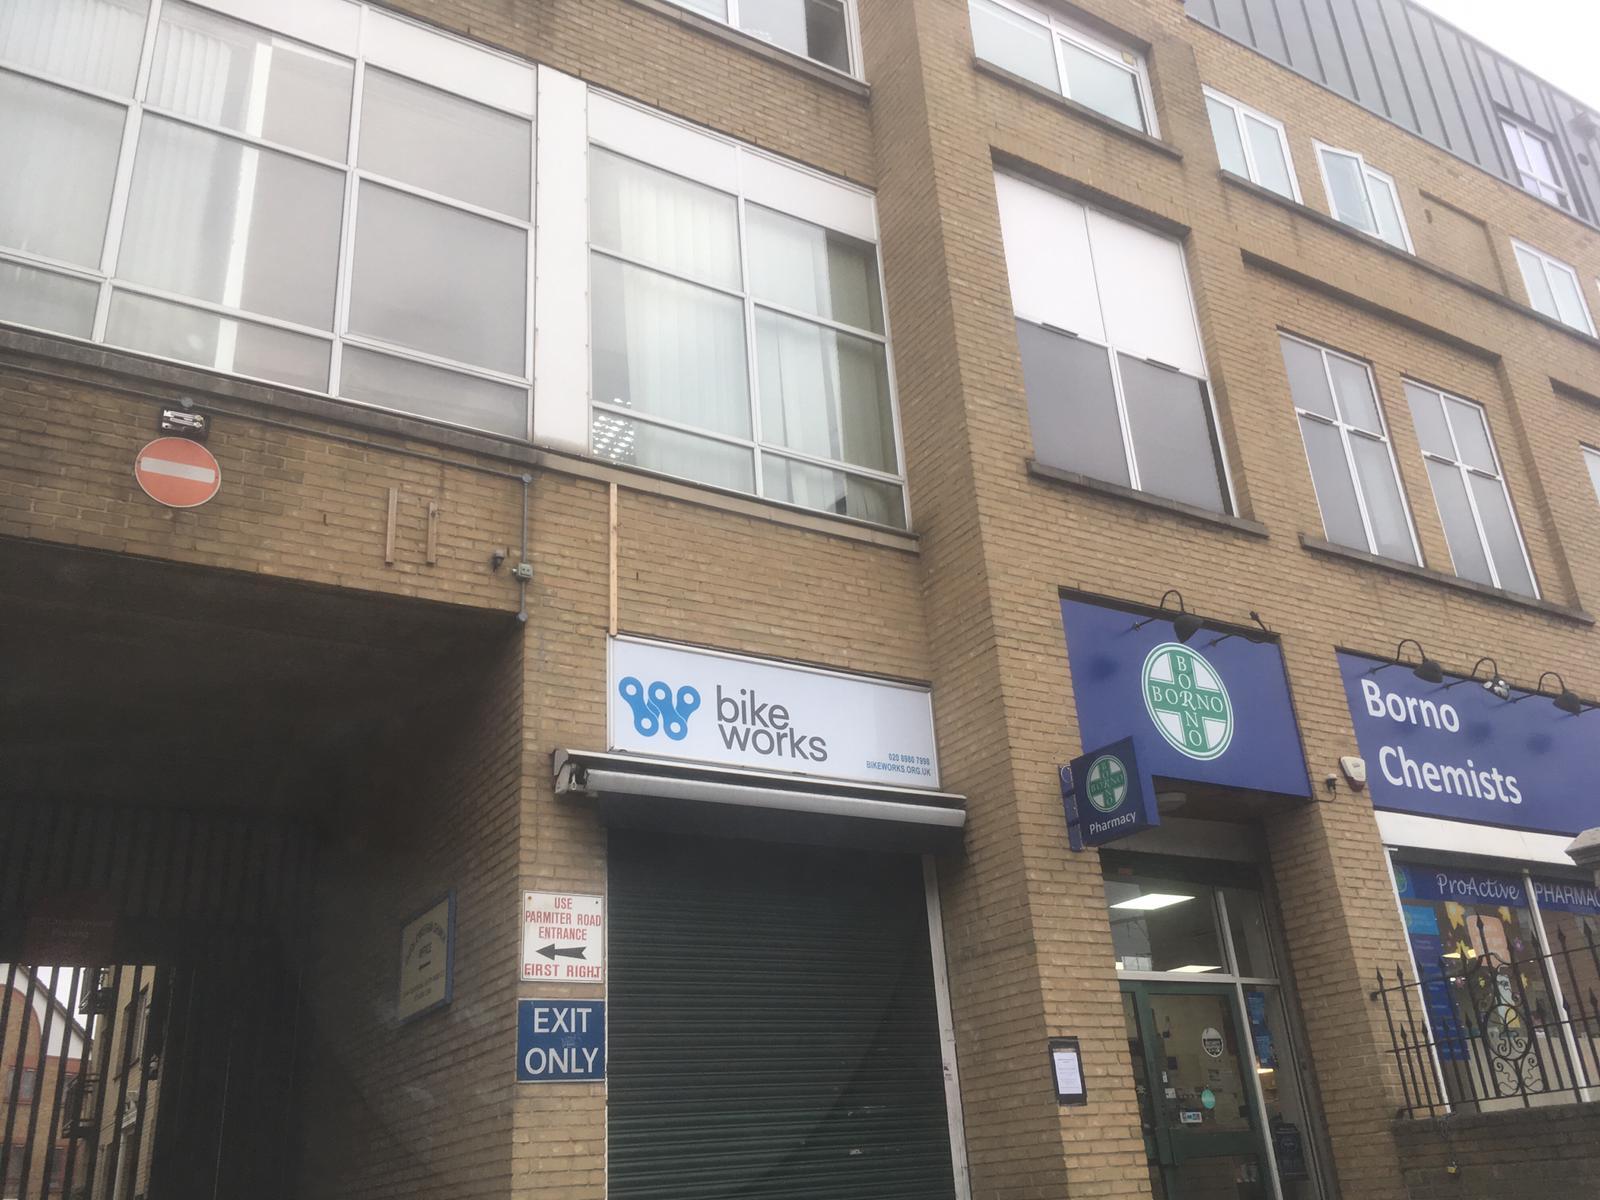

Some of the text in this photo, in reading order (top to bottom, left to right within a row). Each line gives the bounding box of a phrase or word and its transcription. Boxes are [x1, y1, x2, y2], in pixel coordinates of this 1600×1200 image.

[716, 684, 790, 730] bike
[1152, 685, 1223, 713] BORNO
[1176, 655, 1202, 746] BORNO
[1361, 678, 1460, 733] Borno
[717, 723, 828, 762] works
[866, 760, 931, 776] BIKEWORKS.ORG.UK
[1378, 745, 1523, 805] Chemists
[1089, 811, 1136, 835] Pharmacy
[1436, 873, 1520, 900] ProActive
[554, 897, 573, 910] USE
[525, 910, 601, 927] PARMITER ROAD
[538, 926, 587, 941] ENTRANCE
[524, 963, 602, 978] FIRST RIGHT
[533, 1007, 592, 1033] EXIT
[524, 1047, 599, 1075] ONLY
